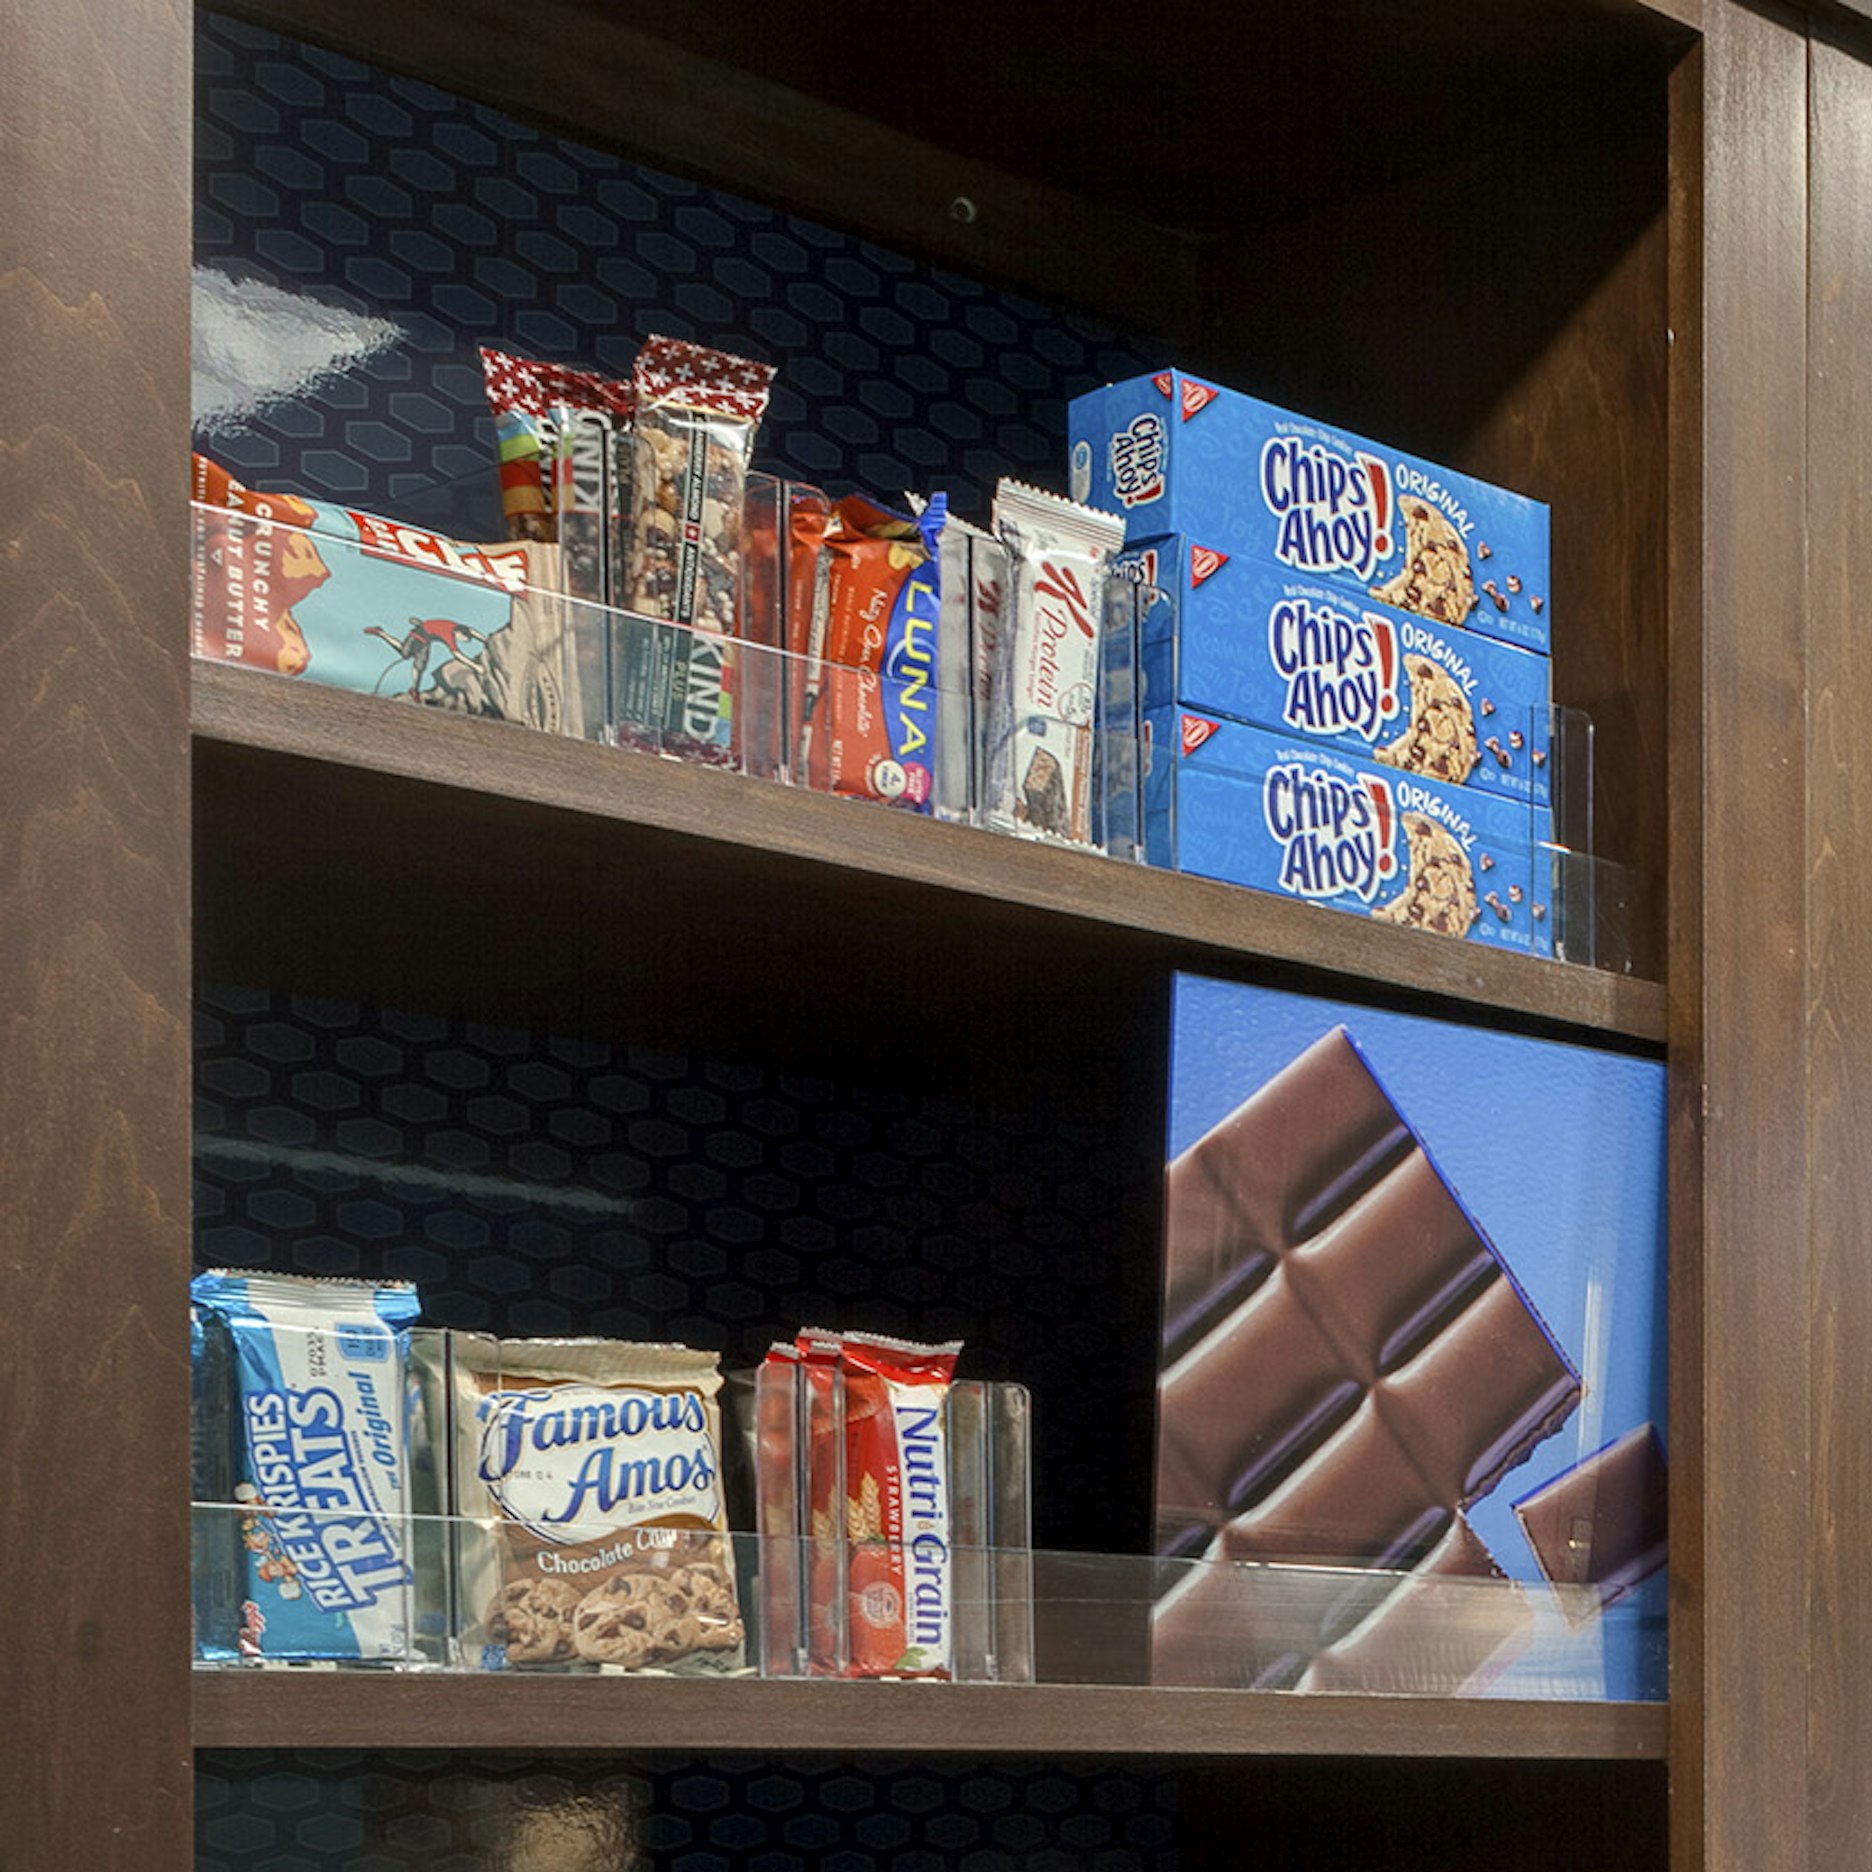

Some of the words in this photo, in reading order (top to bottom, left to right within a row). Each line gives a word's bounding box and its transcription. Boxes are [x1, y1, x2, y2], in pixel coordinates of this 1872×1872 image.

[1132, 417, 1160, 487] Chips
[1262, 438, 1368, 514] Chips
[225, 479, 246, 558] EANUT
[1396, 463, 1476, 539] ORIGINAL
[252, 503, 273, 632] CRUNCHY
[397, 520, 527, 592] CLIF
[225, 566, 244, 658] BUTTER
[1271, 600, 1377, 681] Chips
[682, 630, 723, 741] KIND
[899, 579, 933, 757] LUNA
[1036, 606, 1067, 709] Protein
[1401, 622, 1480, 696] ORIGINAL
[1264, 764, 1371, 840] Chips
[1396, 780, 1479, 853] ORIGINAL
[348, 1371, 397, 1467] Original
[475, 1388, 705, 1481] Famous
[248, 1390, 315, 1543] KRISPIES
[288, 1386, 404, 1605] TREATS
[541, 1446, 716, 1523] Amos
[896, 1405, 943, 1520] Nutri
[537, 1540, 634, 1575] Chocolate
[885, 1463, 904, 1577] STRAWBERRY
[287, 1540, 348, 1608] RICE
[910, 1532, 949, 1646] Grain
